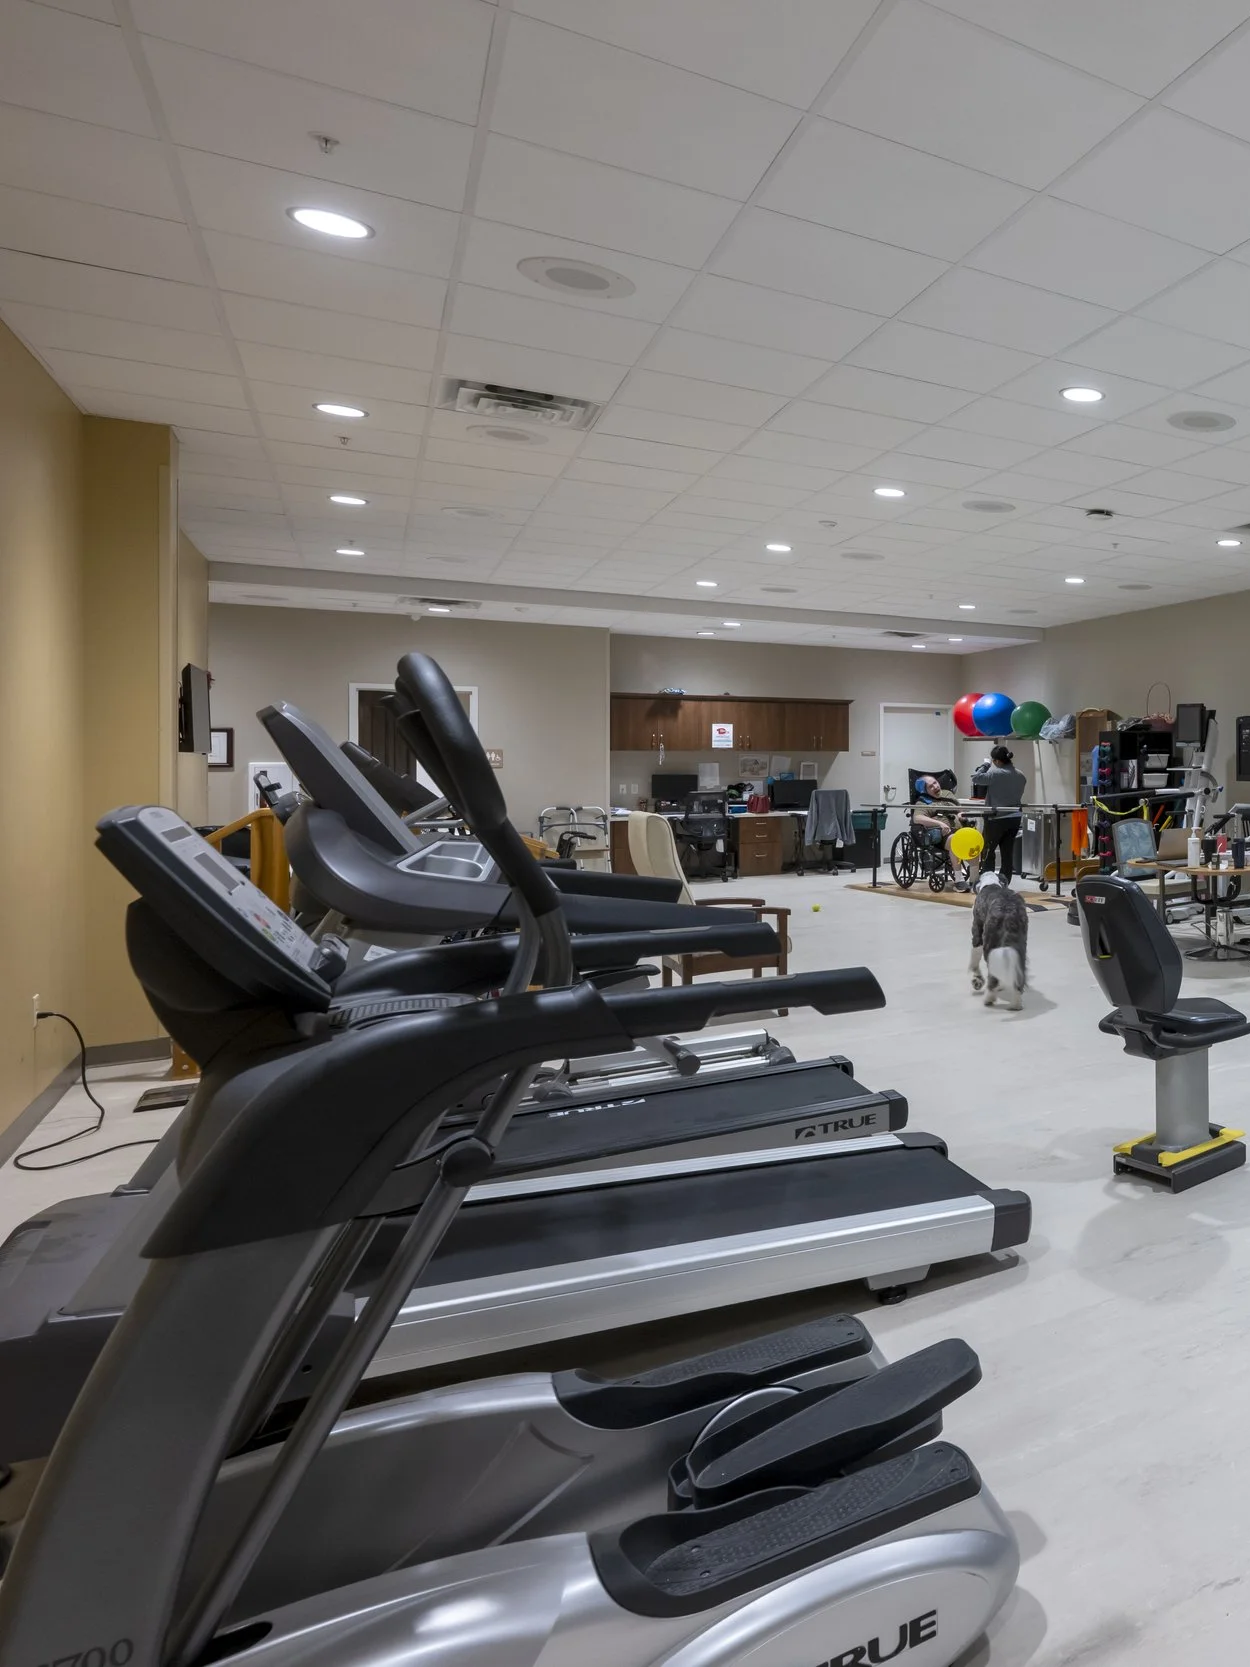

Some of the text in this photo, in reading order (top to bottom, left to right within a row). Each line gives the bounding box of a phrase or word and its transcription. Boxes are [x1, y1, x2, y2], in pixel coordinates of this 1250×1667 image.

[818, 1113, 876, 1134] TRUE
[38, 1638, 134, 1667] 700
[815, 1609, 937, 1667] RUE
